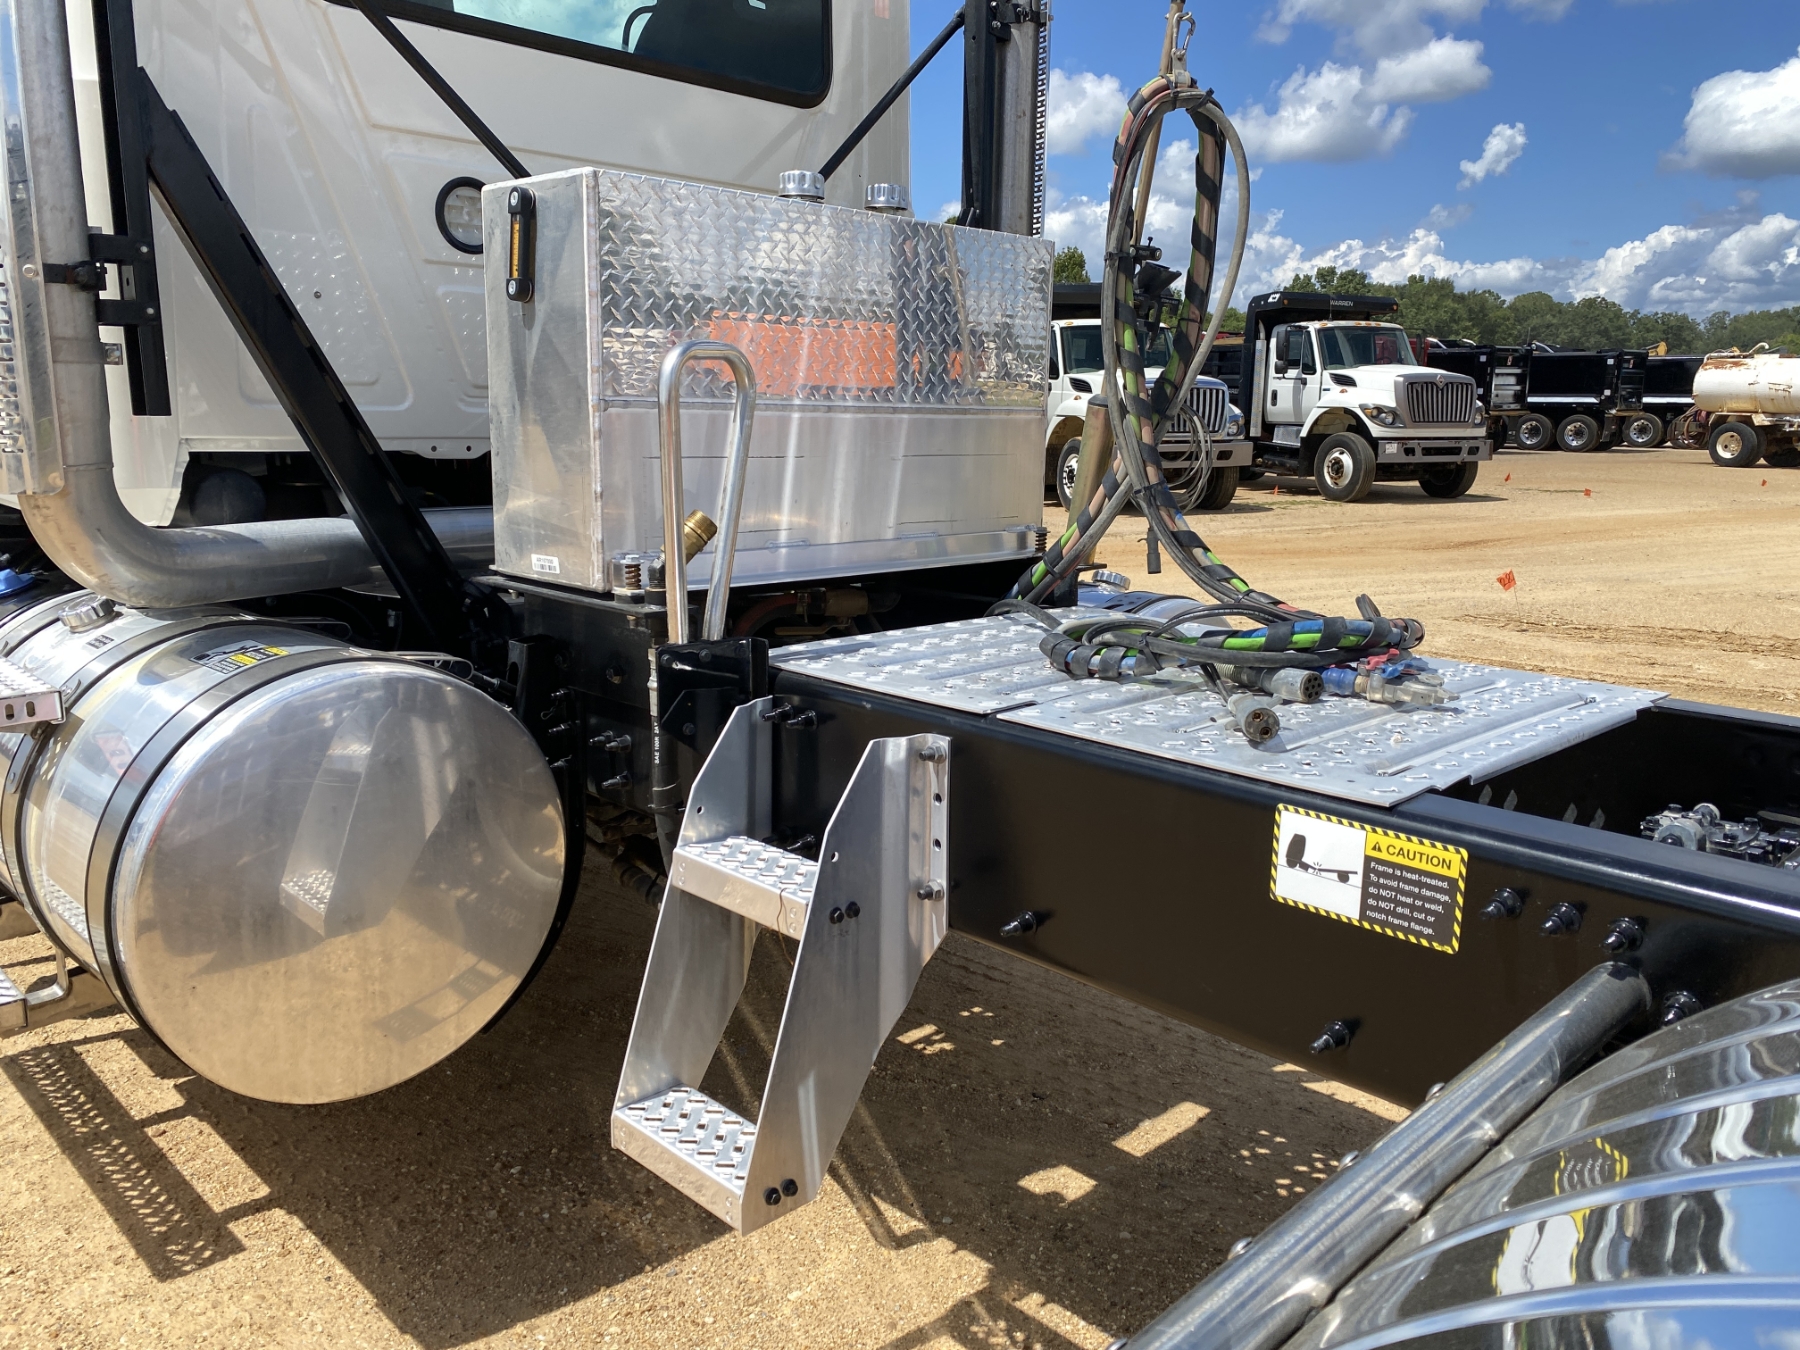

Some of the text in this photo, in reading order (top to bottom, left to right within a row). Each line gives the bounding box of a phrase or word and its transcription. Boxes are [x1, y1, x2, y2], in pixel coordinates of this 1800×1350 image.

[1330, 299, 1354, 307] WARREN
[1386, 844, 1452, 871] CAUTION
[1369, 873, 1452, 903] To avoid frame damage,
[1370, 861, 1450, 889] Frame is heat-treated.
[1367, 898, 1436, 923] do NOT drill, cut or
[1368, 886, 1444, 914] do NOT heat or weld,
[1366, 910, 1435, 936] notch frame flange.
